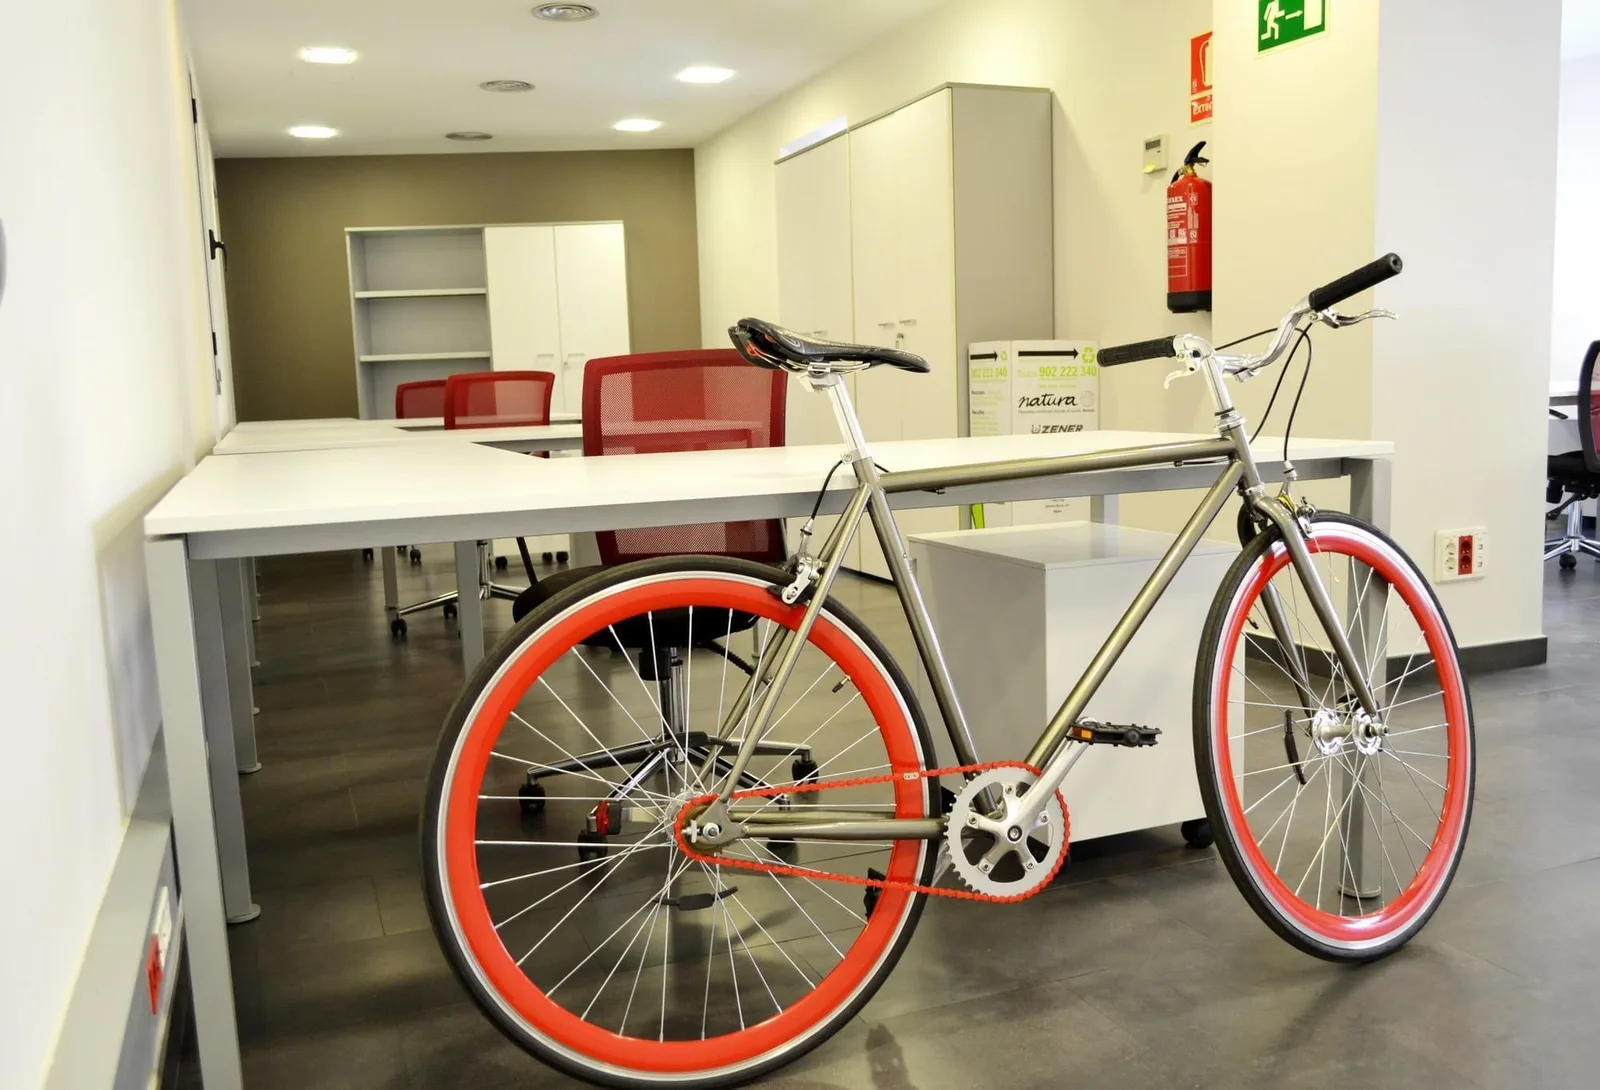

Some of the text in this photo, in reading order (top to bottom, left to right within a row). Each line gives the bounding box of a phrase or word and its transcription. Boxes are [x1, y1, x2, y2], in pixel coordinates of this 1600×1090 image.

[995, 365, 1008, 378] 340
[1039, 366, 1058, 377] 902
[1060, 366, 1078, 377] 222
[1080, 365, 1097, 377] 340
[1018, 393, 1078, 408] natura
[1041, 424, 1084, 435] ZENER
